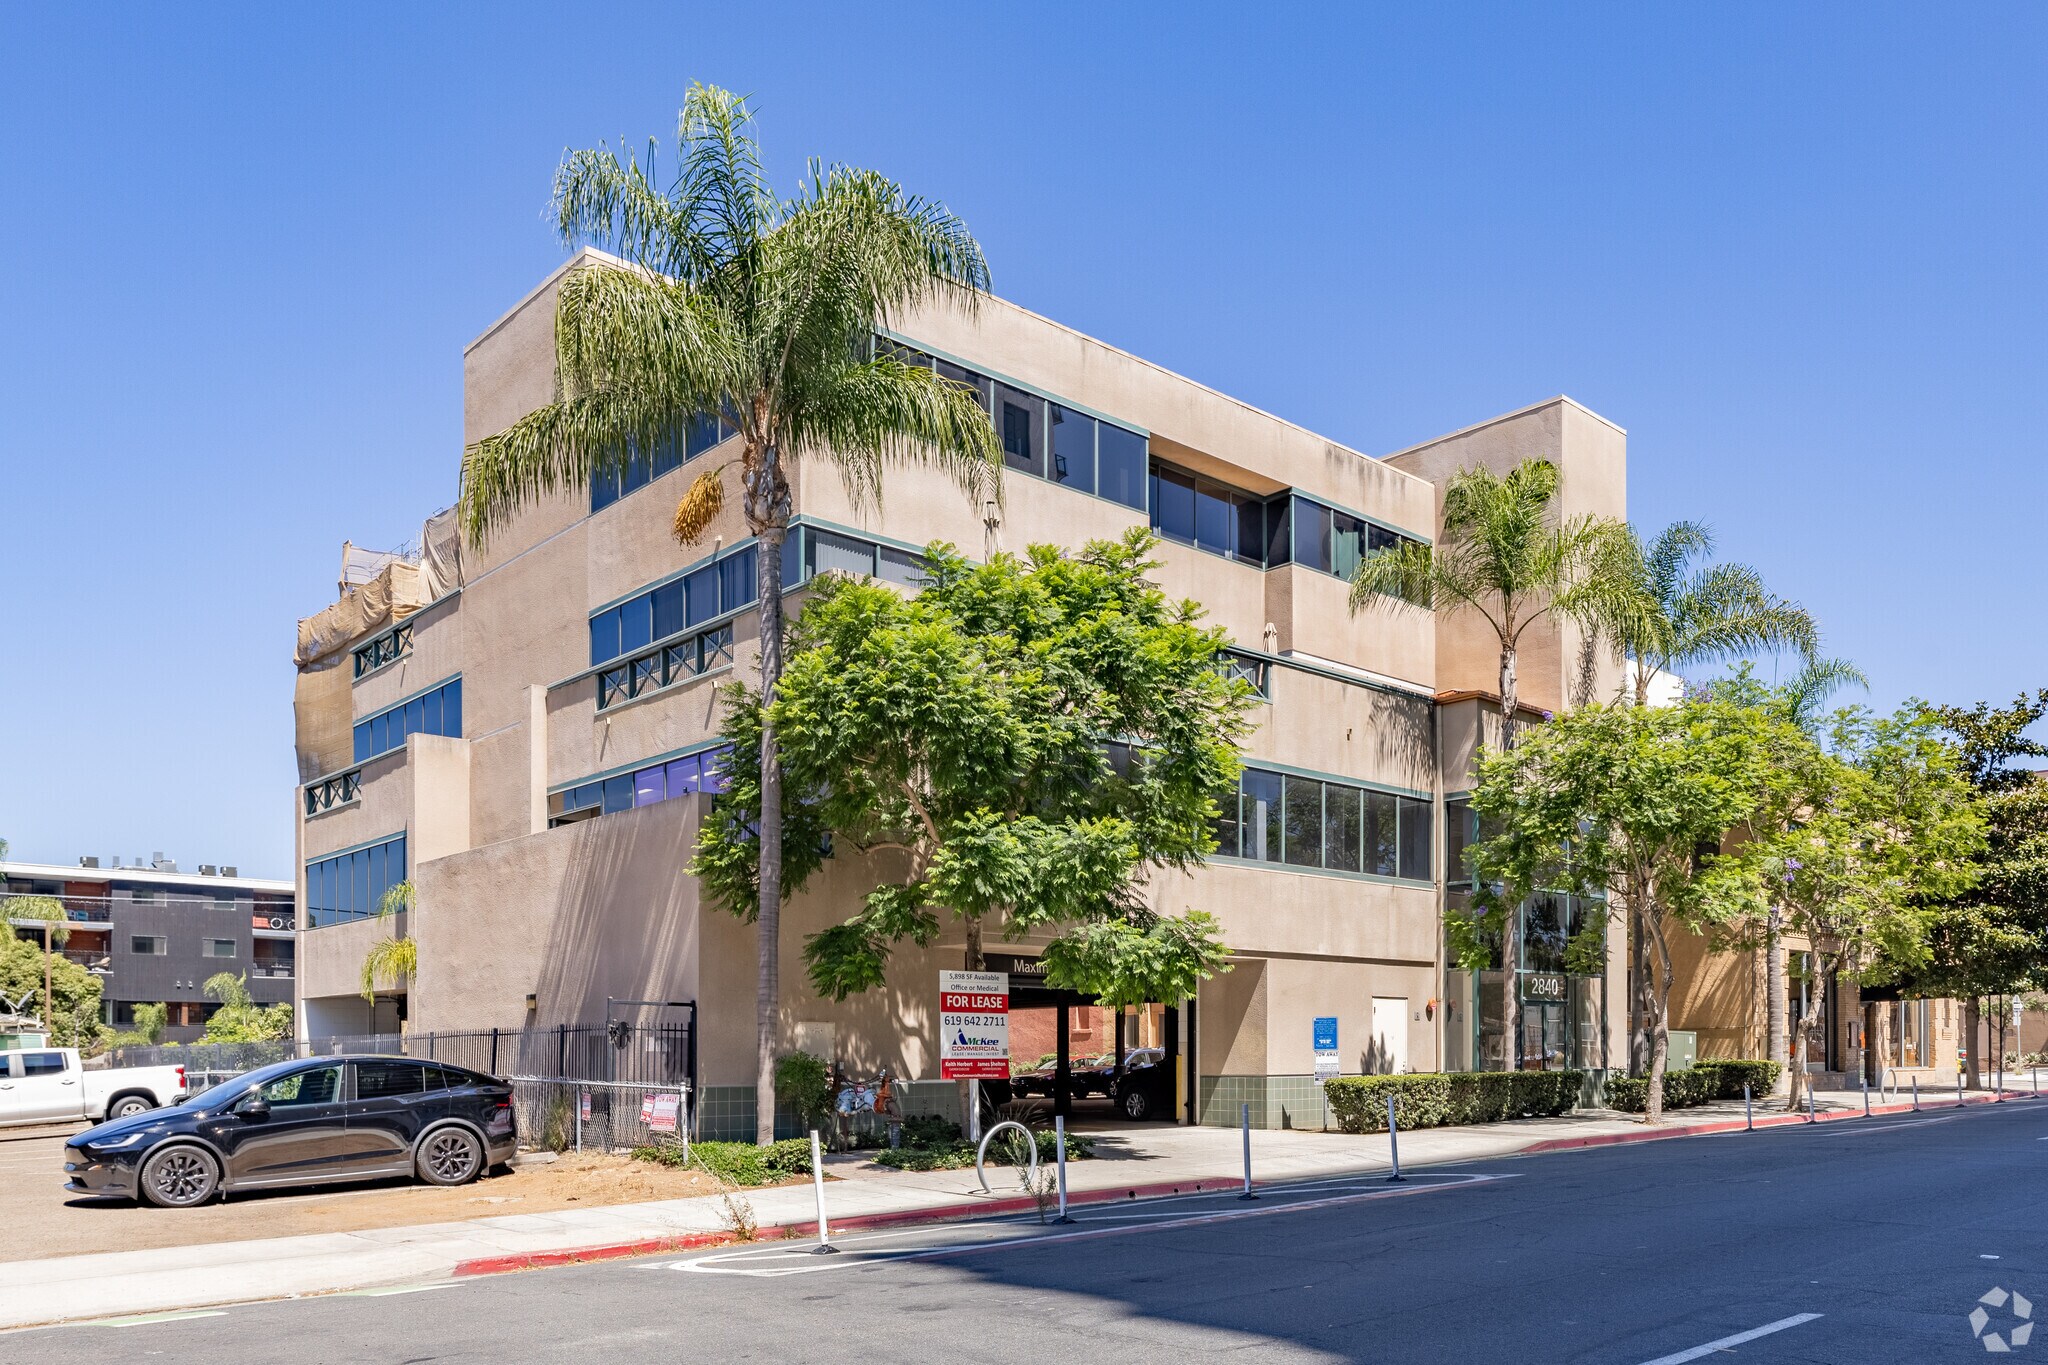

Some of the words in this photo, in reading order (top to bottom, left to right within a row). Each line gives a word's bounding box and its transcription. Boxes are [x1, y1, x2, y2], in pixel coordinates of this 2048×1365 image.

[1014, 959, 1050, 974] Maxim
[1531, 977, 1559, 996] 2840
[946, 995, 969, 1008] FOR
[971, 996, 1003, 1009] LEASE
[944, 1015, 962, 1026] 619
[964, 1016, 981, 1026] 642
[983, 1016, 1006, 1027] 2711
[967, 1037, 999, 1046] McKee
